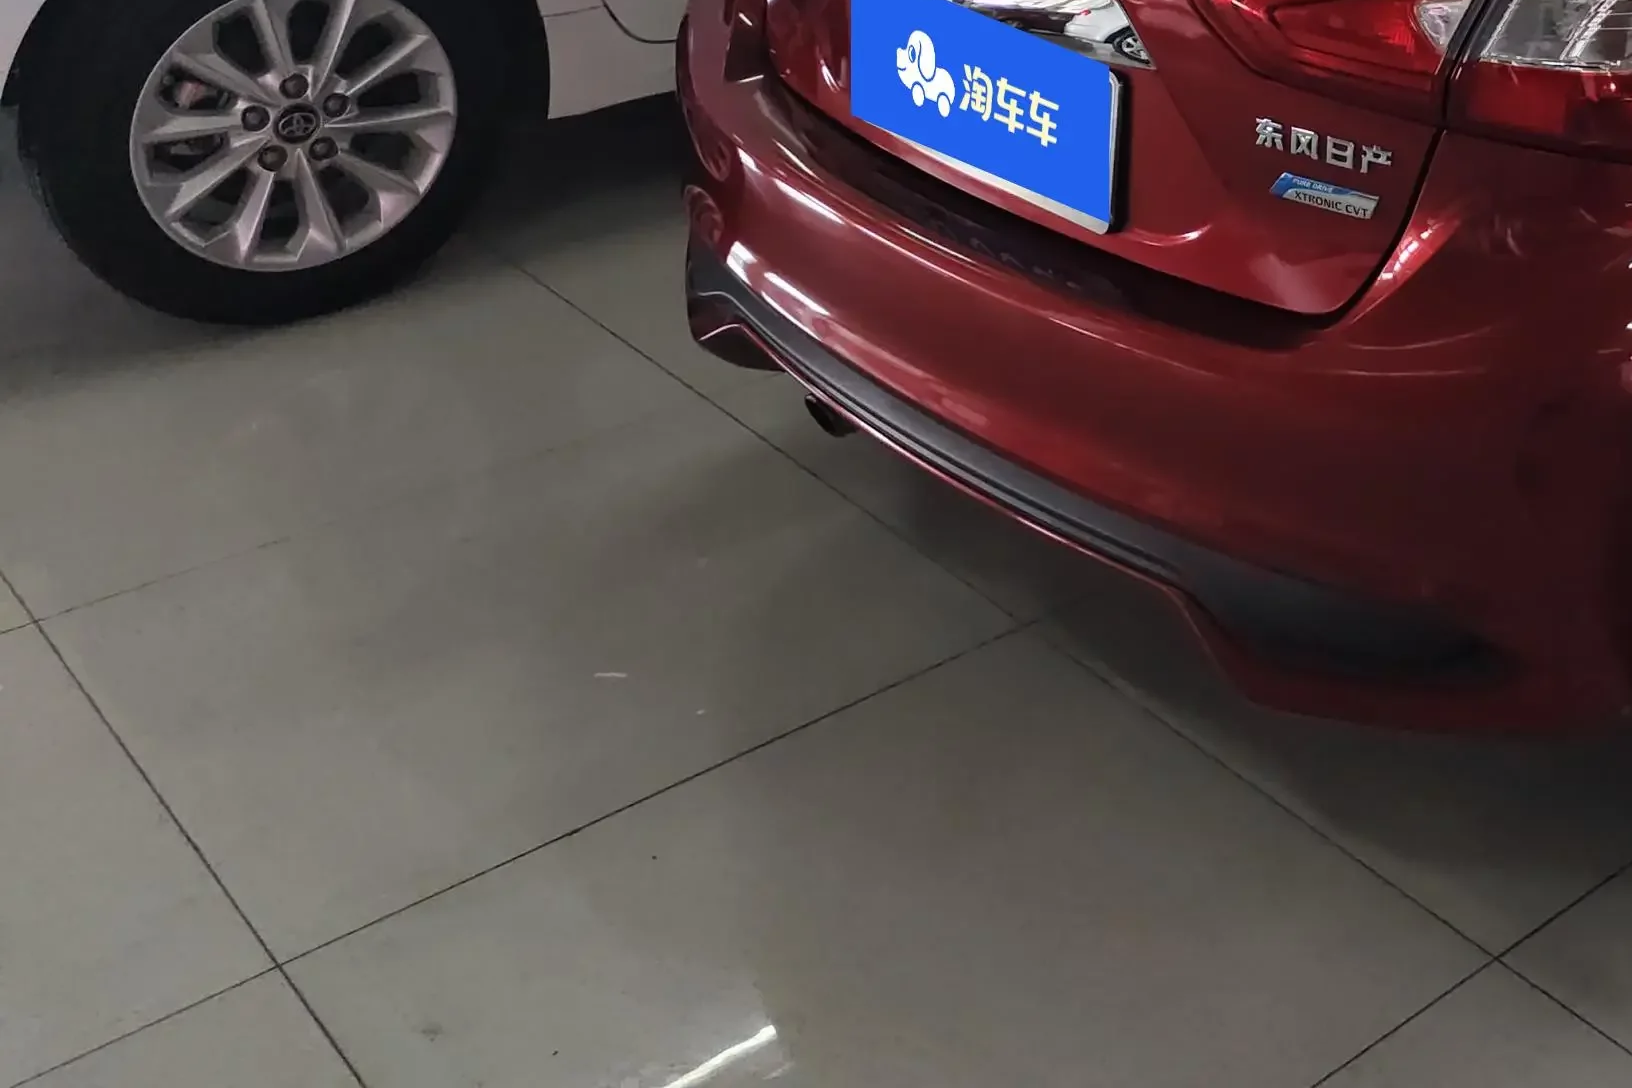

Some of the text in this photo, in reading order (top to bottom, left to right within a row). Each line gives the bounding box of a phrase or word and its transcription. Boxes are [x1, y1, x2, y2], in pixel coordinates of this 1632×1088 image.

[1255, 116, 1392, 174] 东风日产
[1294, 190, 1369, 217] XTRONIC CVT
